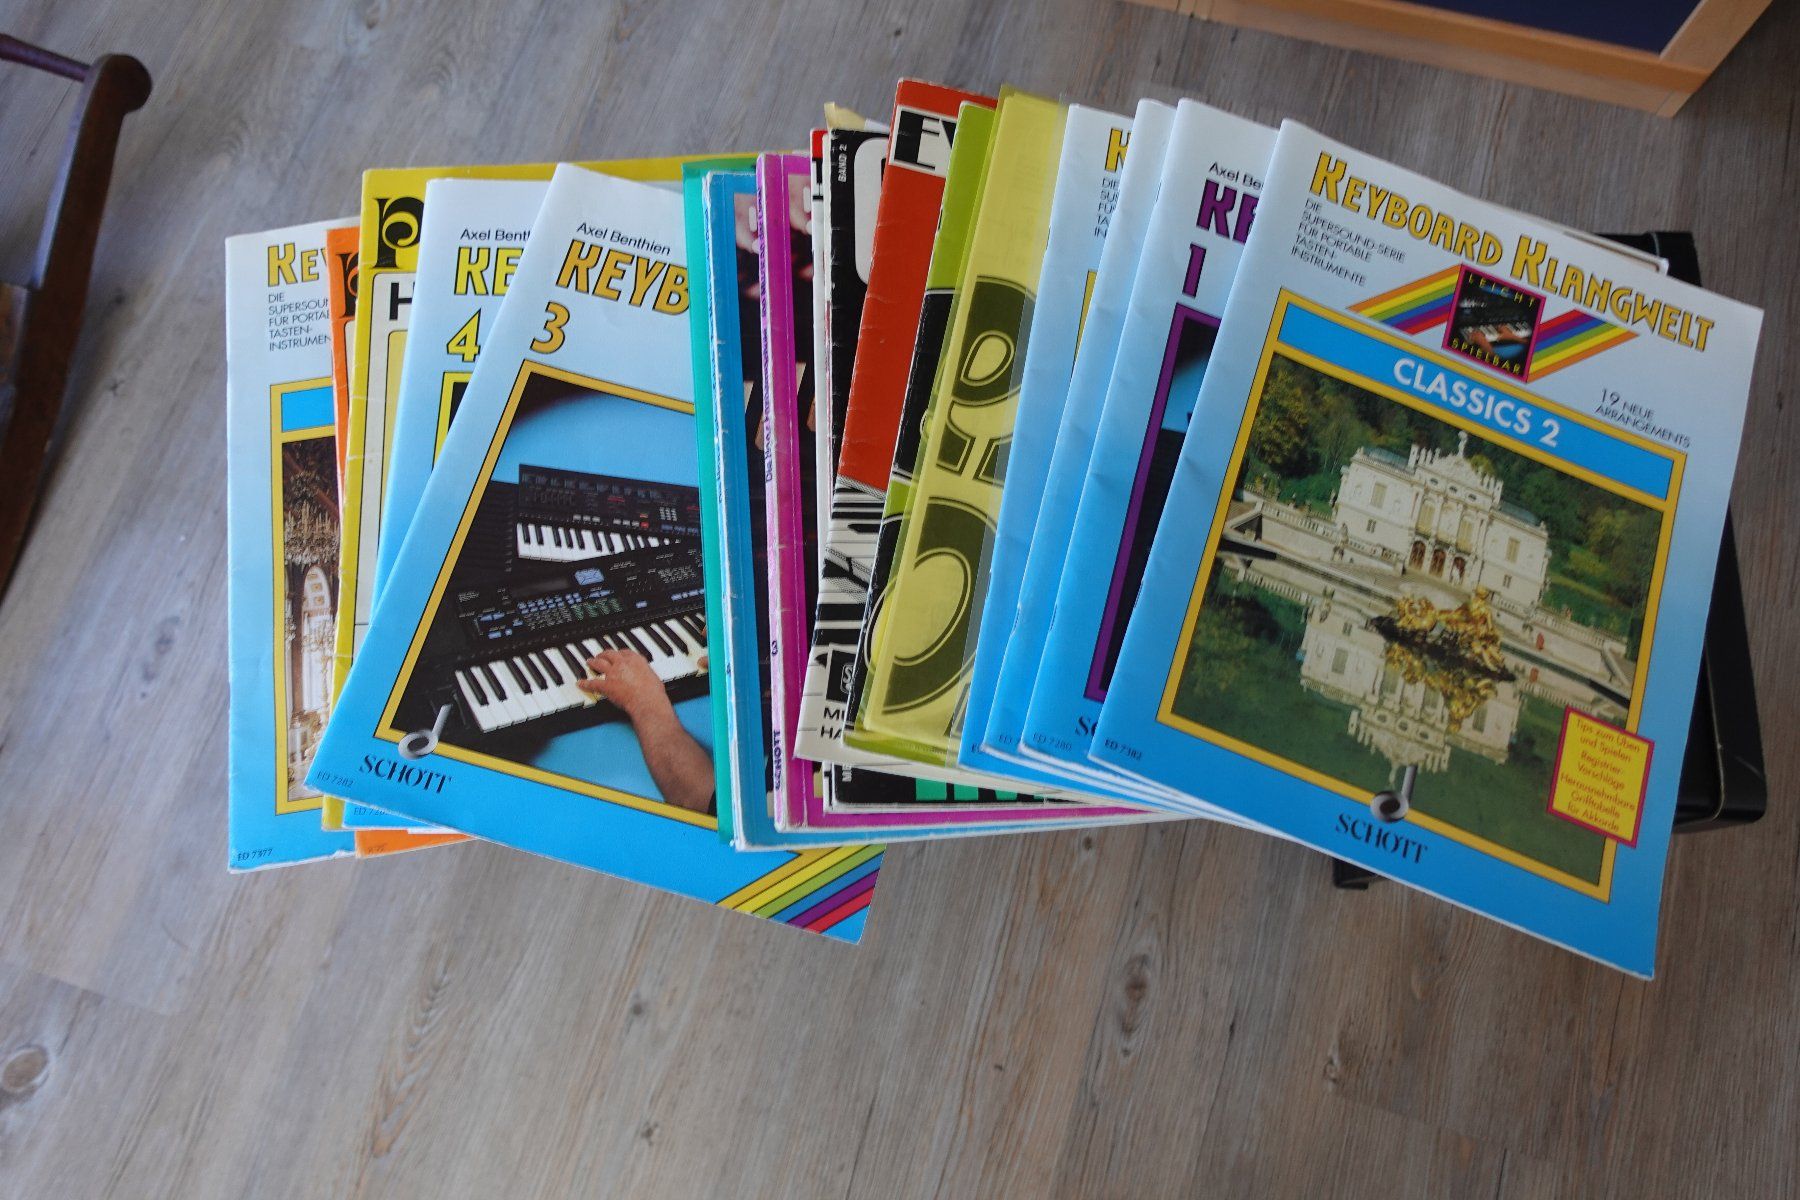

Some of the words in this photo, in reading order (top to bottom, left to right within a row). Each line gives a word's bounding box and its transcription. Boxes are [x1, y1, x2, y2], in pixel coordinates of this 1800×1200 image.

[839, 143, 848, 152] 2
[837, 153, 848, 183] BAND
[1208, 161, 1239, 184] Axel
[1305, 198, 1322, 213] DIE
[460, 228, 491, 240] Axel
[576, 221, 608, 240] Axel
[609, 230, 671, 256] Benthien
[1309, 150, 1504, 266] KEYBOARD
[1510, 233, 1716, 353] KLANGWELT
[1320, 232, 1372, 263] PORTABLE
[556, 238, 690, 316] KEYB
[1290, 244, 1367, 287] INSTRUMENTE
[268, 292, 285, 304] DIE
[1467, 273, 1536, 309] LEICHT
[446, 307, 481, 363] 4
[529, 300, 571, 355] 3
[1451, 337, 1522, 376] SPIELBAR
[1393, 357, 1533, 435] CLASSICS
[1539, 418, 1561, 449] 2
[1601, 388, 1620, 407] 19
[1622, 401, 1655, 419] NEUE
[1594, 404, 1691, 449] ARRANGEMENTS
[359, 754, 453, 794] SCHOTT
[1335, 813, 1429, 865] SCHOTT
